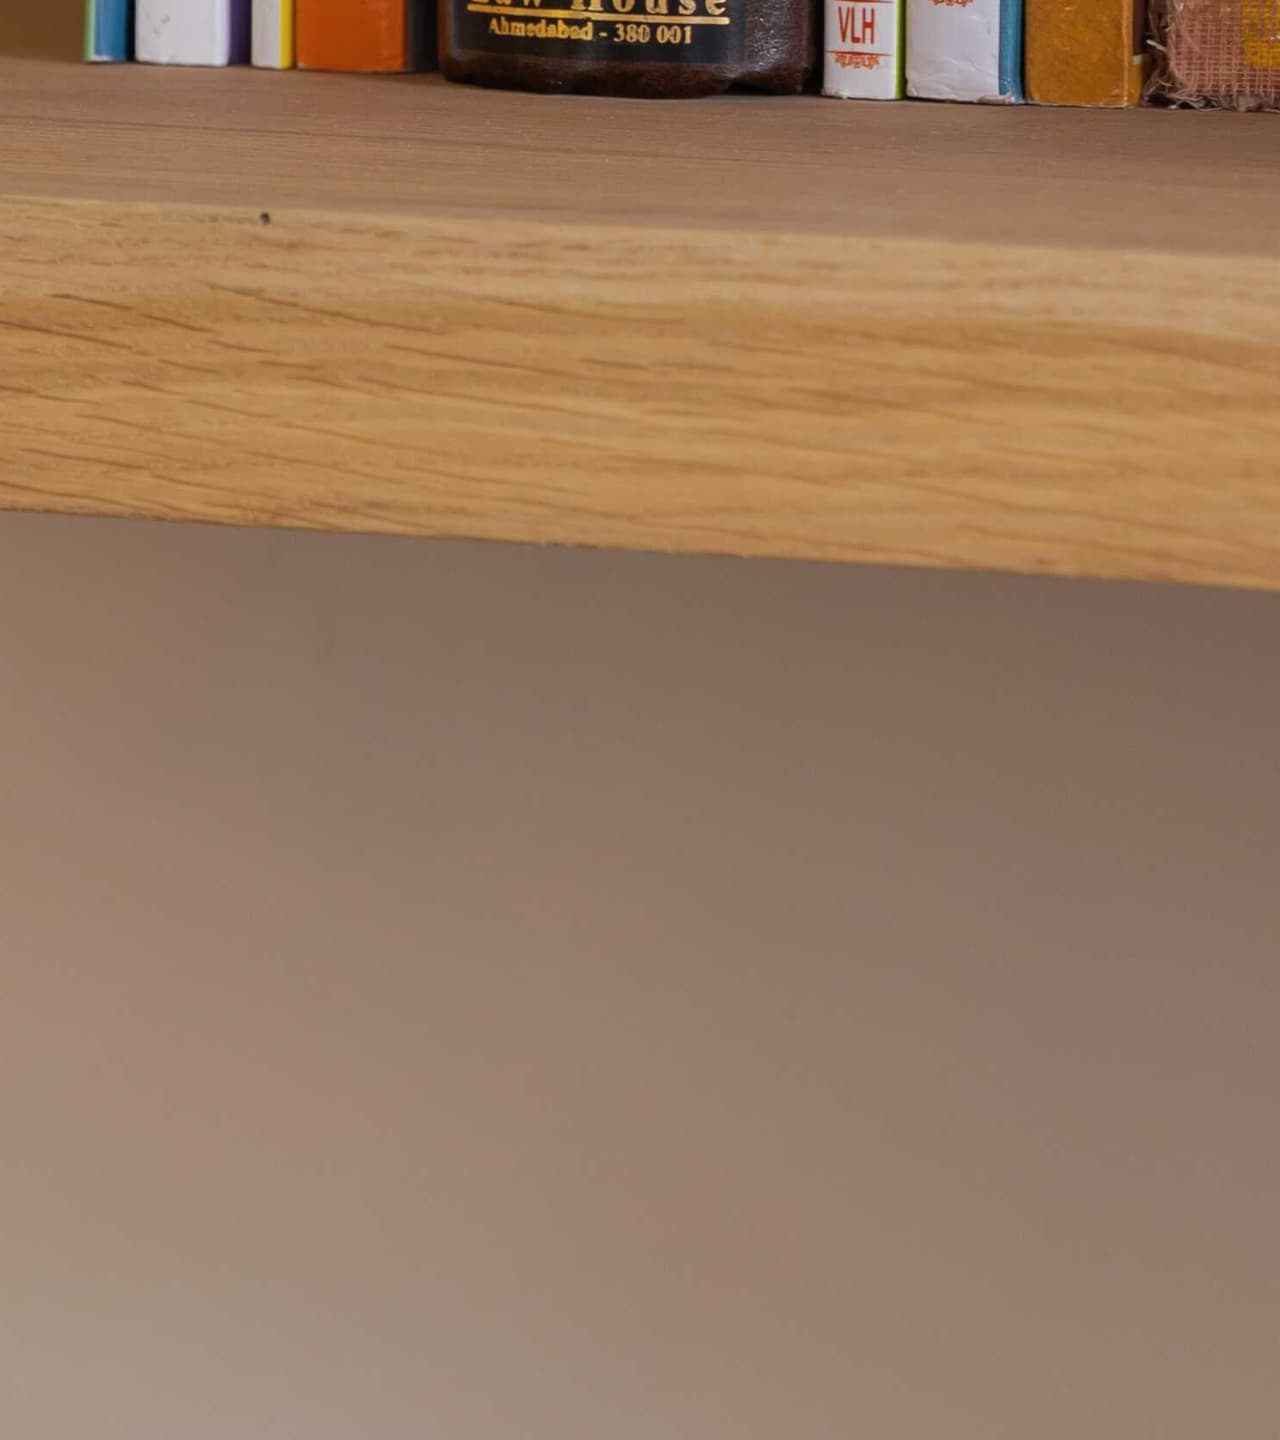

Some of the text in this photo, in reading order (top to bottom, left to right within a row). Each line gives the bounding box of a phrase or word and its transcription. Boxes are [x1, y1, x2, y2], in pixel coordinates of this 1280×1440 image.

[489, 17, 593, 41] Ahmedabad
[613, 23, 650, 44] 380
[656, 25, 692, 45] 001
[838, 7, 876, 45] VLH
